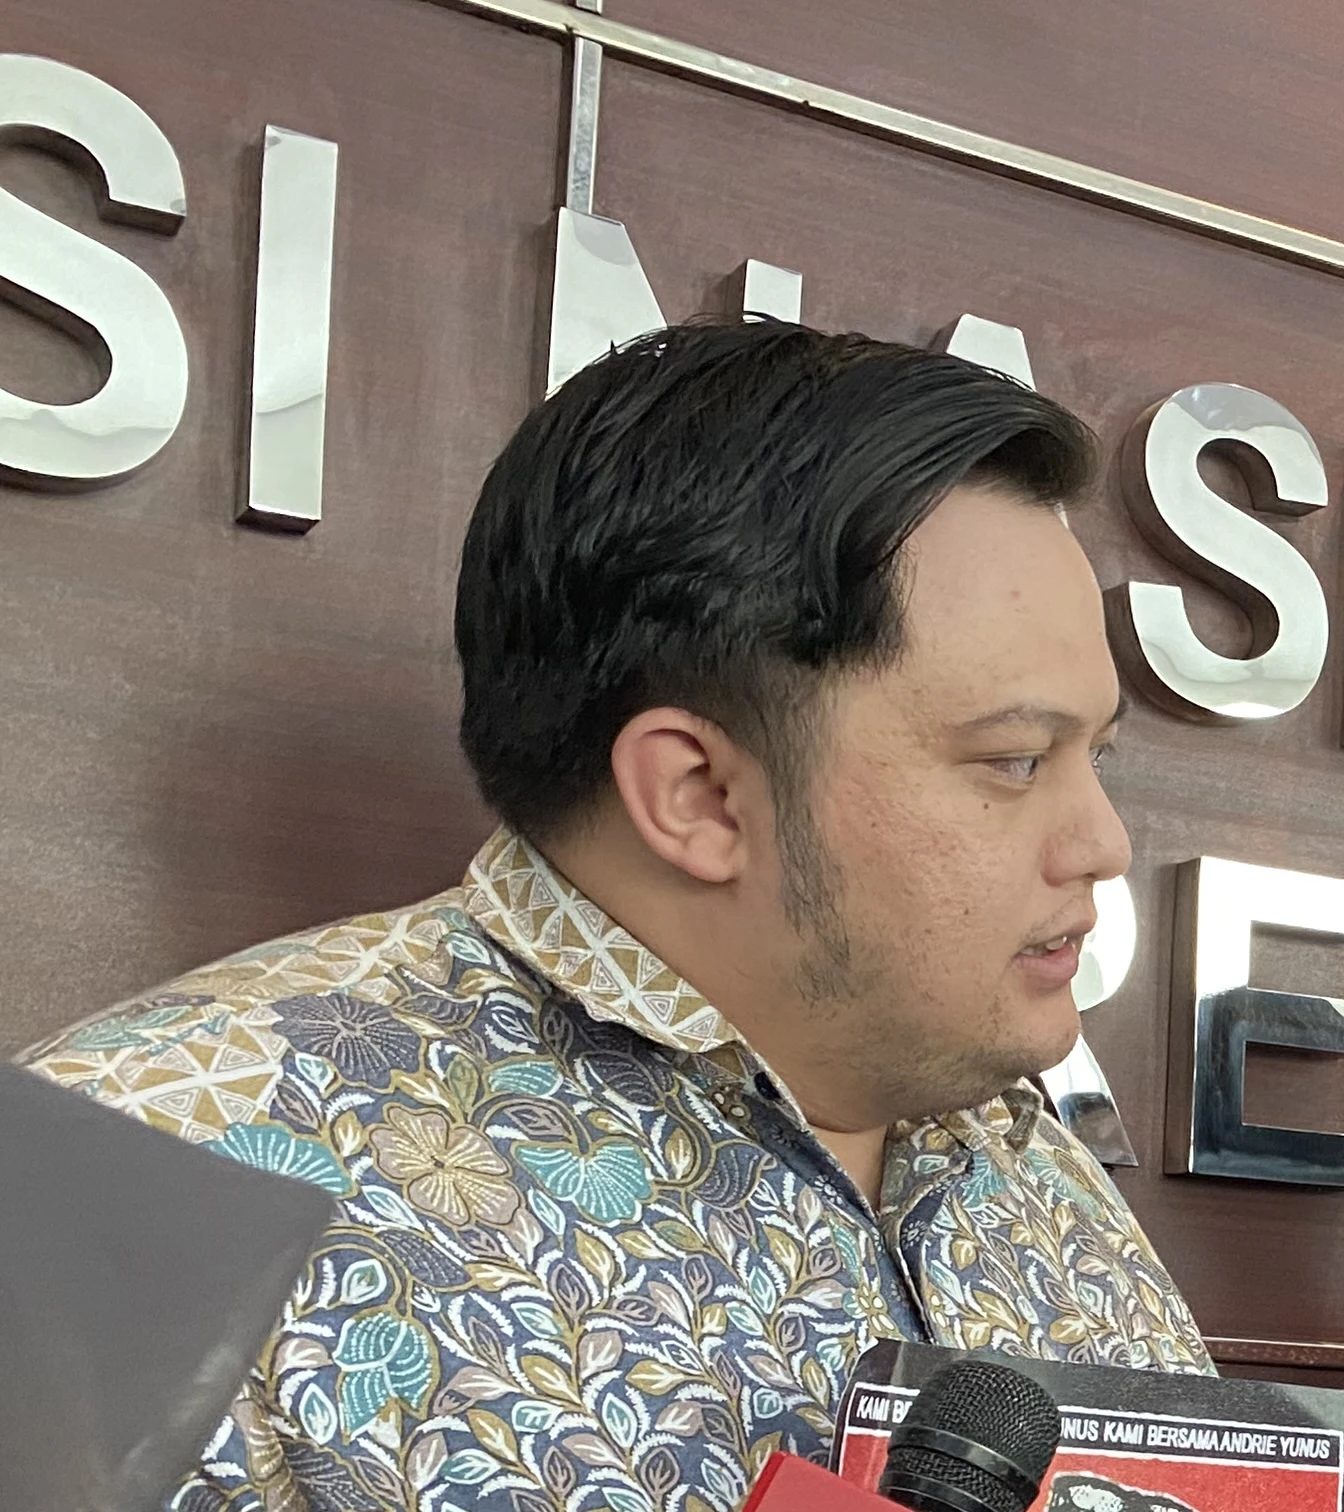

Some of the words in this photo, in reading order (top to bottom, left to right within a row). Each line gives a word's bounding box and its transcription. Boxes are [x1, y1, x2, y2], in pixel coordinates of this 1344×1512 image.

[856, 1395, 890, 1421] KAMI
[1060, 1416, 1099, 1441] NUS
[1103, 1421, 1144, 1444] KAMI
[1146, 1426, 1219, 1451] BERSAMA
[1219, 1433, 1277, 1456] ANDRIE
[1280, 1436, 1331, 1459] YUNUS
